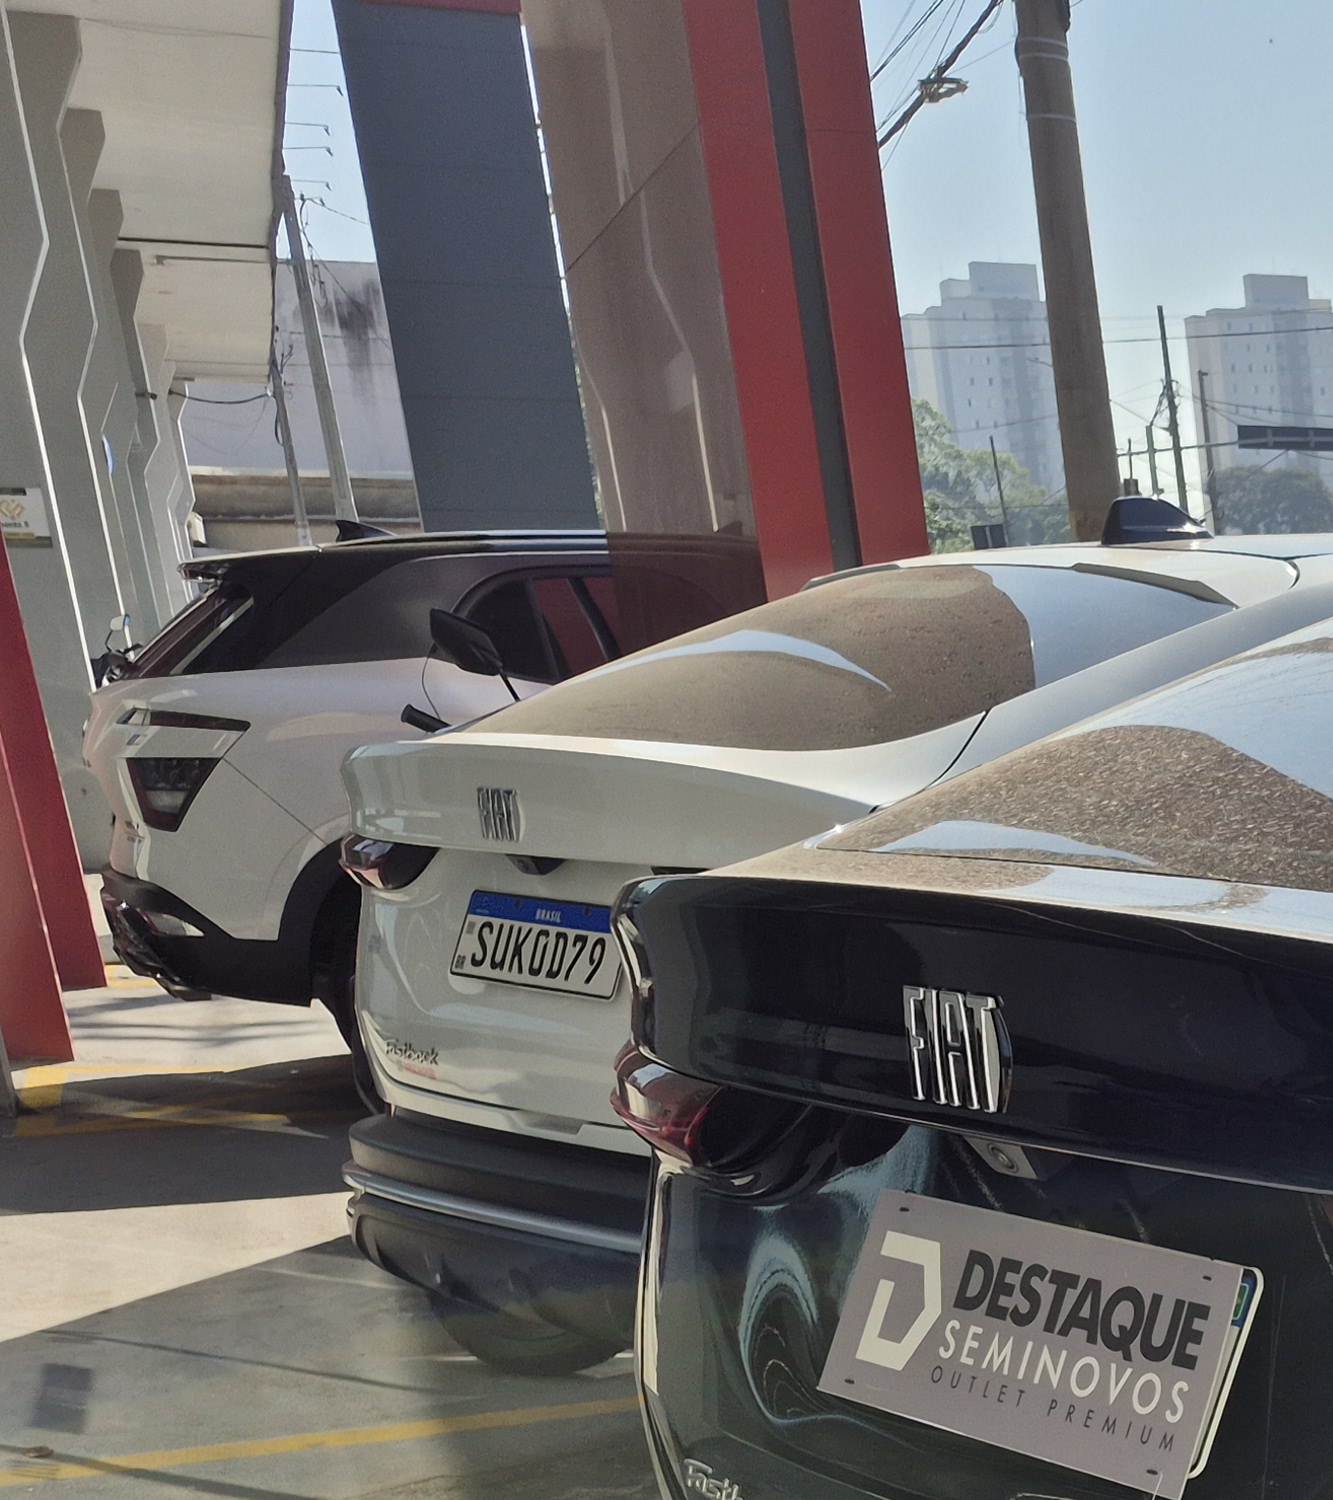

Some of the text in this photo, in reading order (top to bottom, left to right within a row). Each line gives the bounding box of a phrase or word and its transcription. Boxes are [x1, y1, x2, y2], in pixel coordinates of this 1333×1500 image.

[477, 787, 520, 842] FIAT
[535, 908, 562, 923] BRASIL
[903, 985, 1000, 1114] FIAT
[953, 1248, 1211, 1371] DESTAQUE
[931, 1365, 1175, 1453] OUTLET PREMIUM
[938, 1319, 1189, 1424] SEMINOVOS
